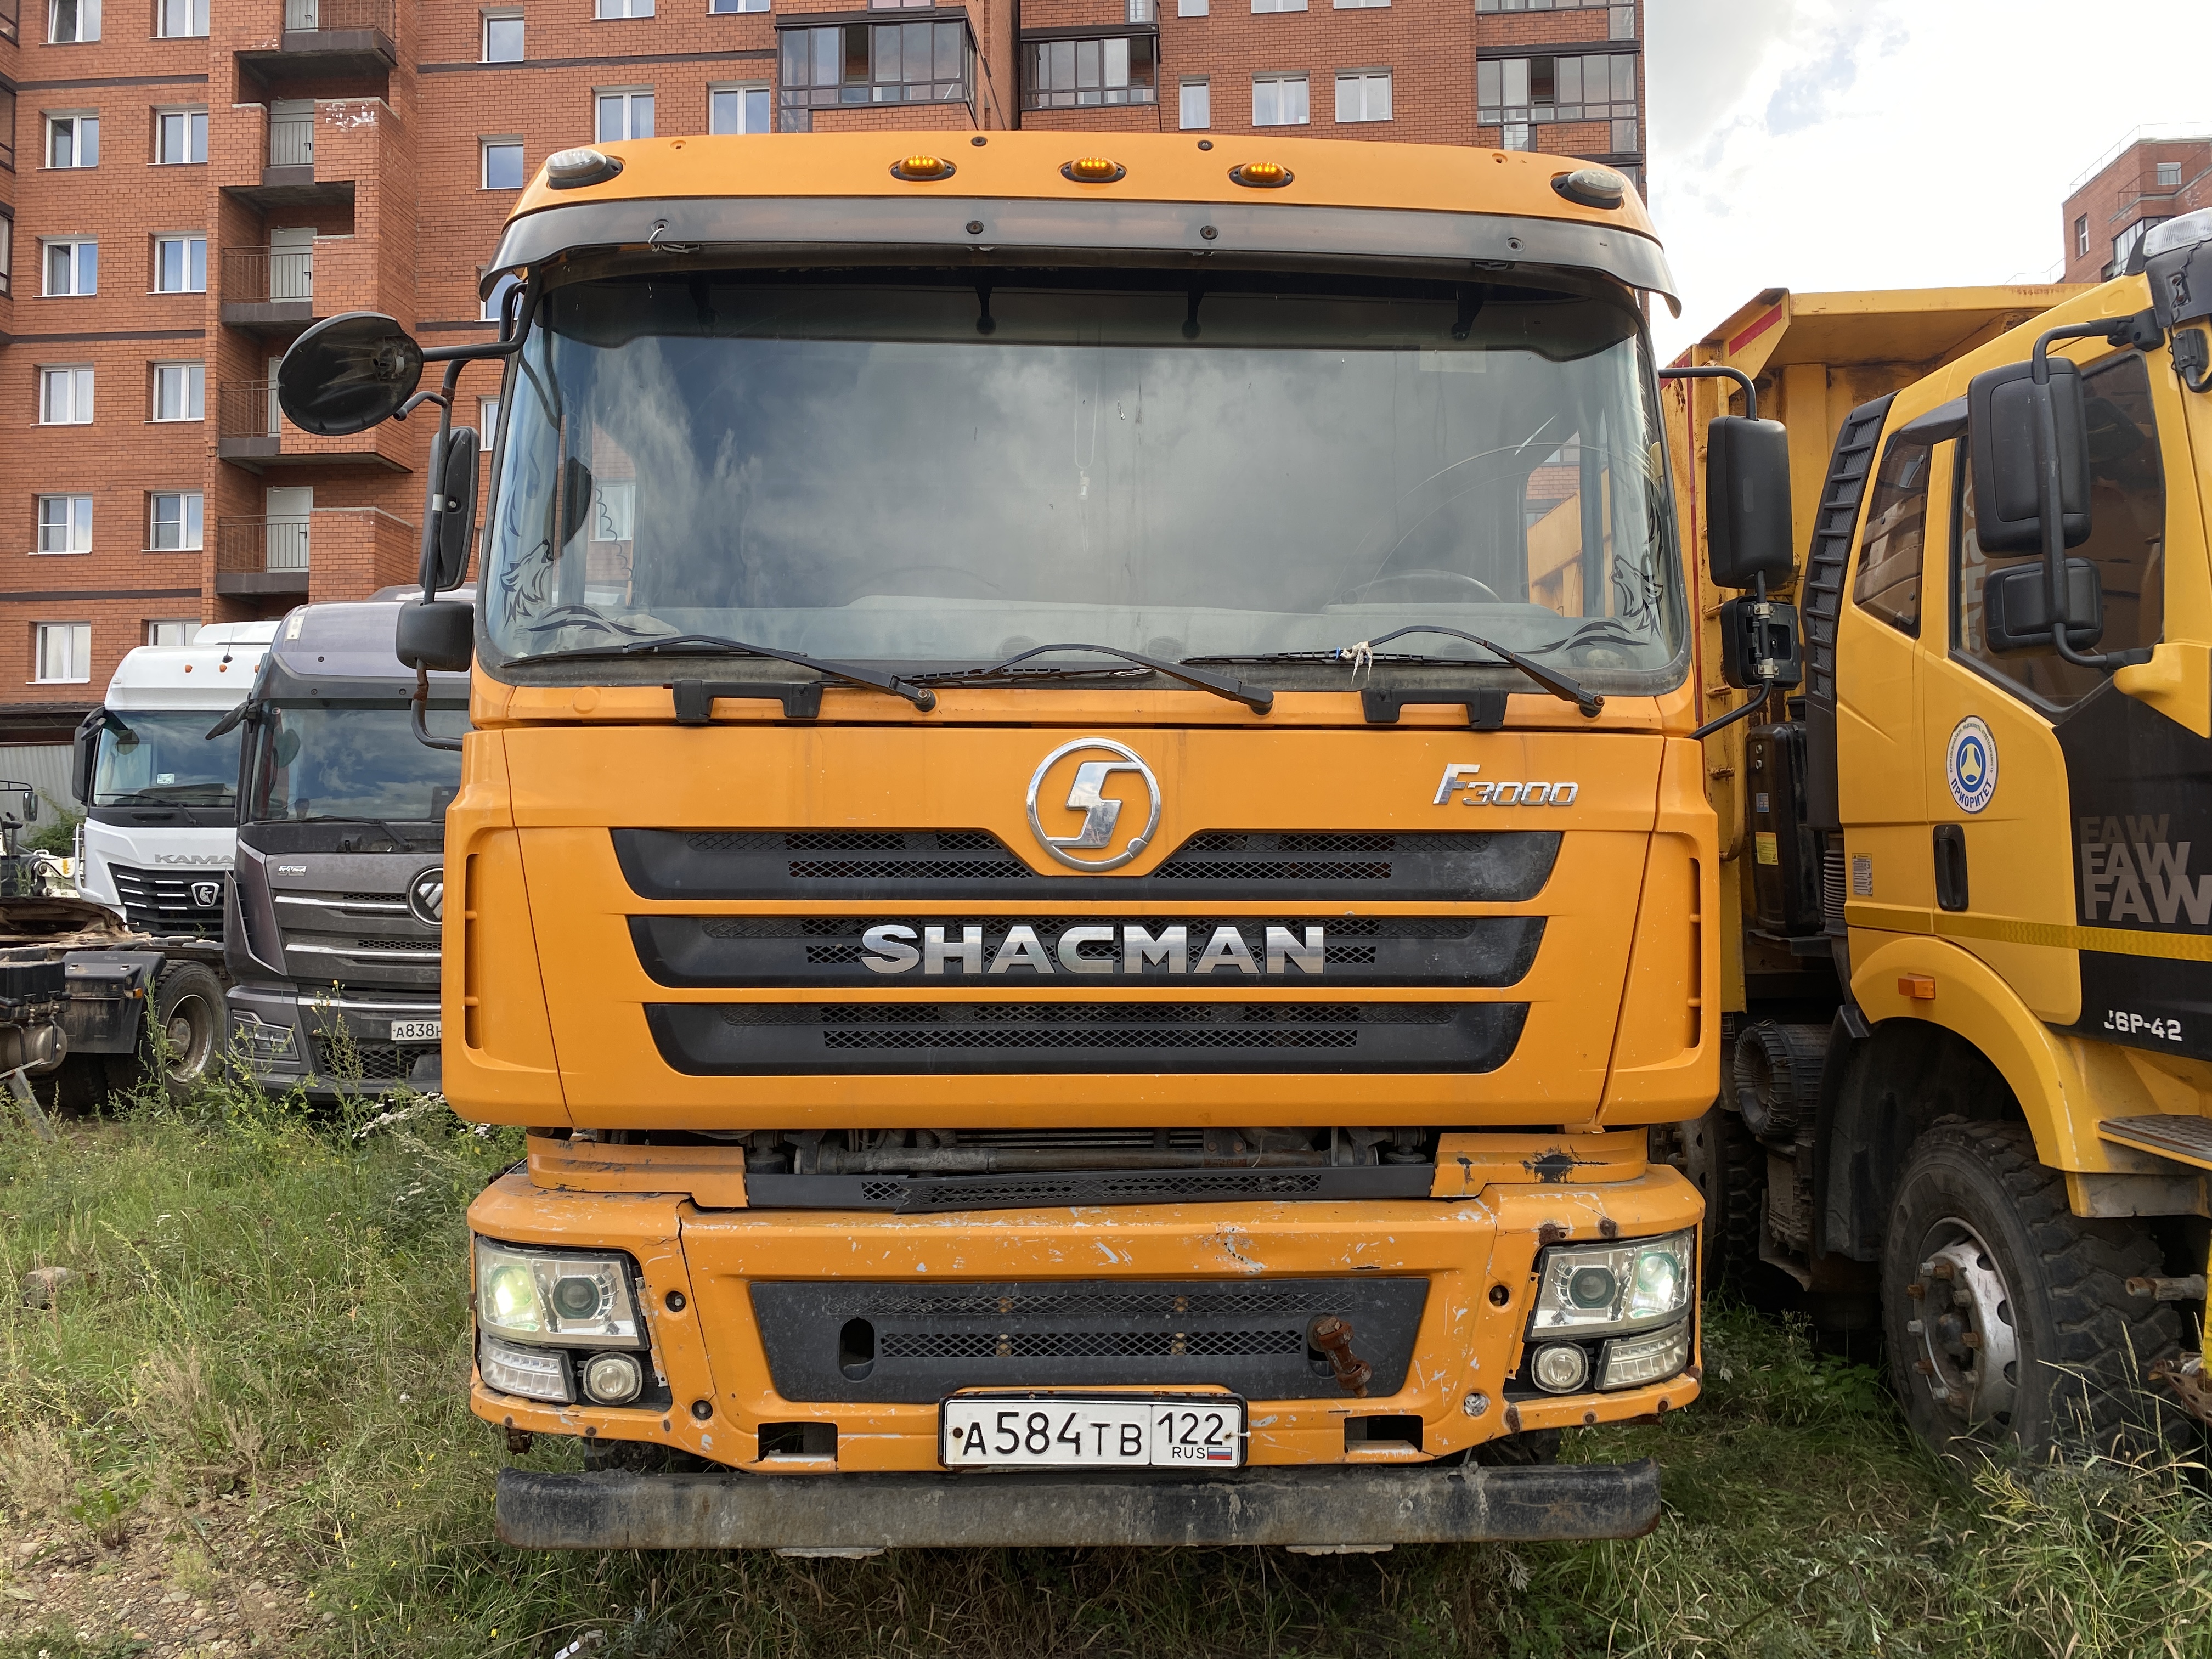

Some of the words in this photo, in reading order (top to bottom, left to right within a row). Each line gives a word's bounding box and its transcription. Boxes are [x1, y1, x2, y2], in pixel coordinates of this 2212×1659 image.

[1432, 763, 1579, 806] F3000
[1951, 778, 1992, 808] ПРИОРИТЕТ
[2080, 814, 2170, 849] FAW
[2081, 842, 2191, 883] FAW
[2083, 874, 2212, 925] FAW
[861, 924, 1325, 974] SHACMAN
[2104, 1010, 2182, 1041] J6P-42
[962, 1412, 1142, 1456] А584ТВ
[1158, 1412, 1223, 1445] 122
[1172, 1447, 1205, 1459] RUS
